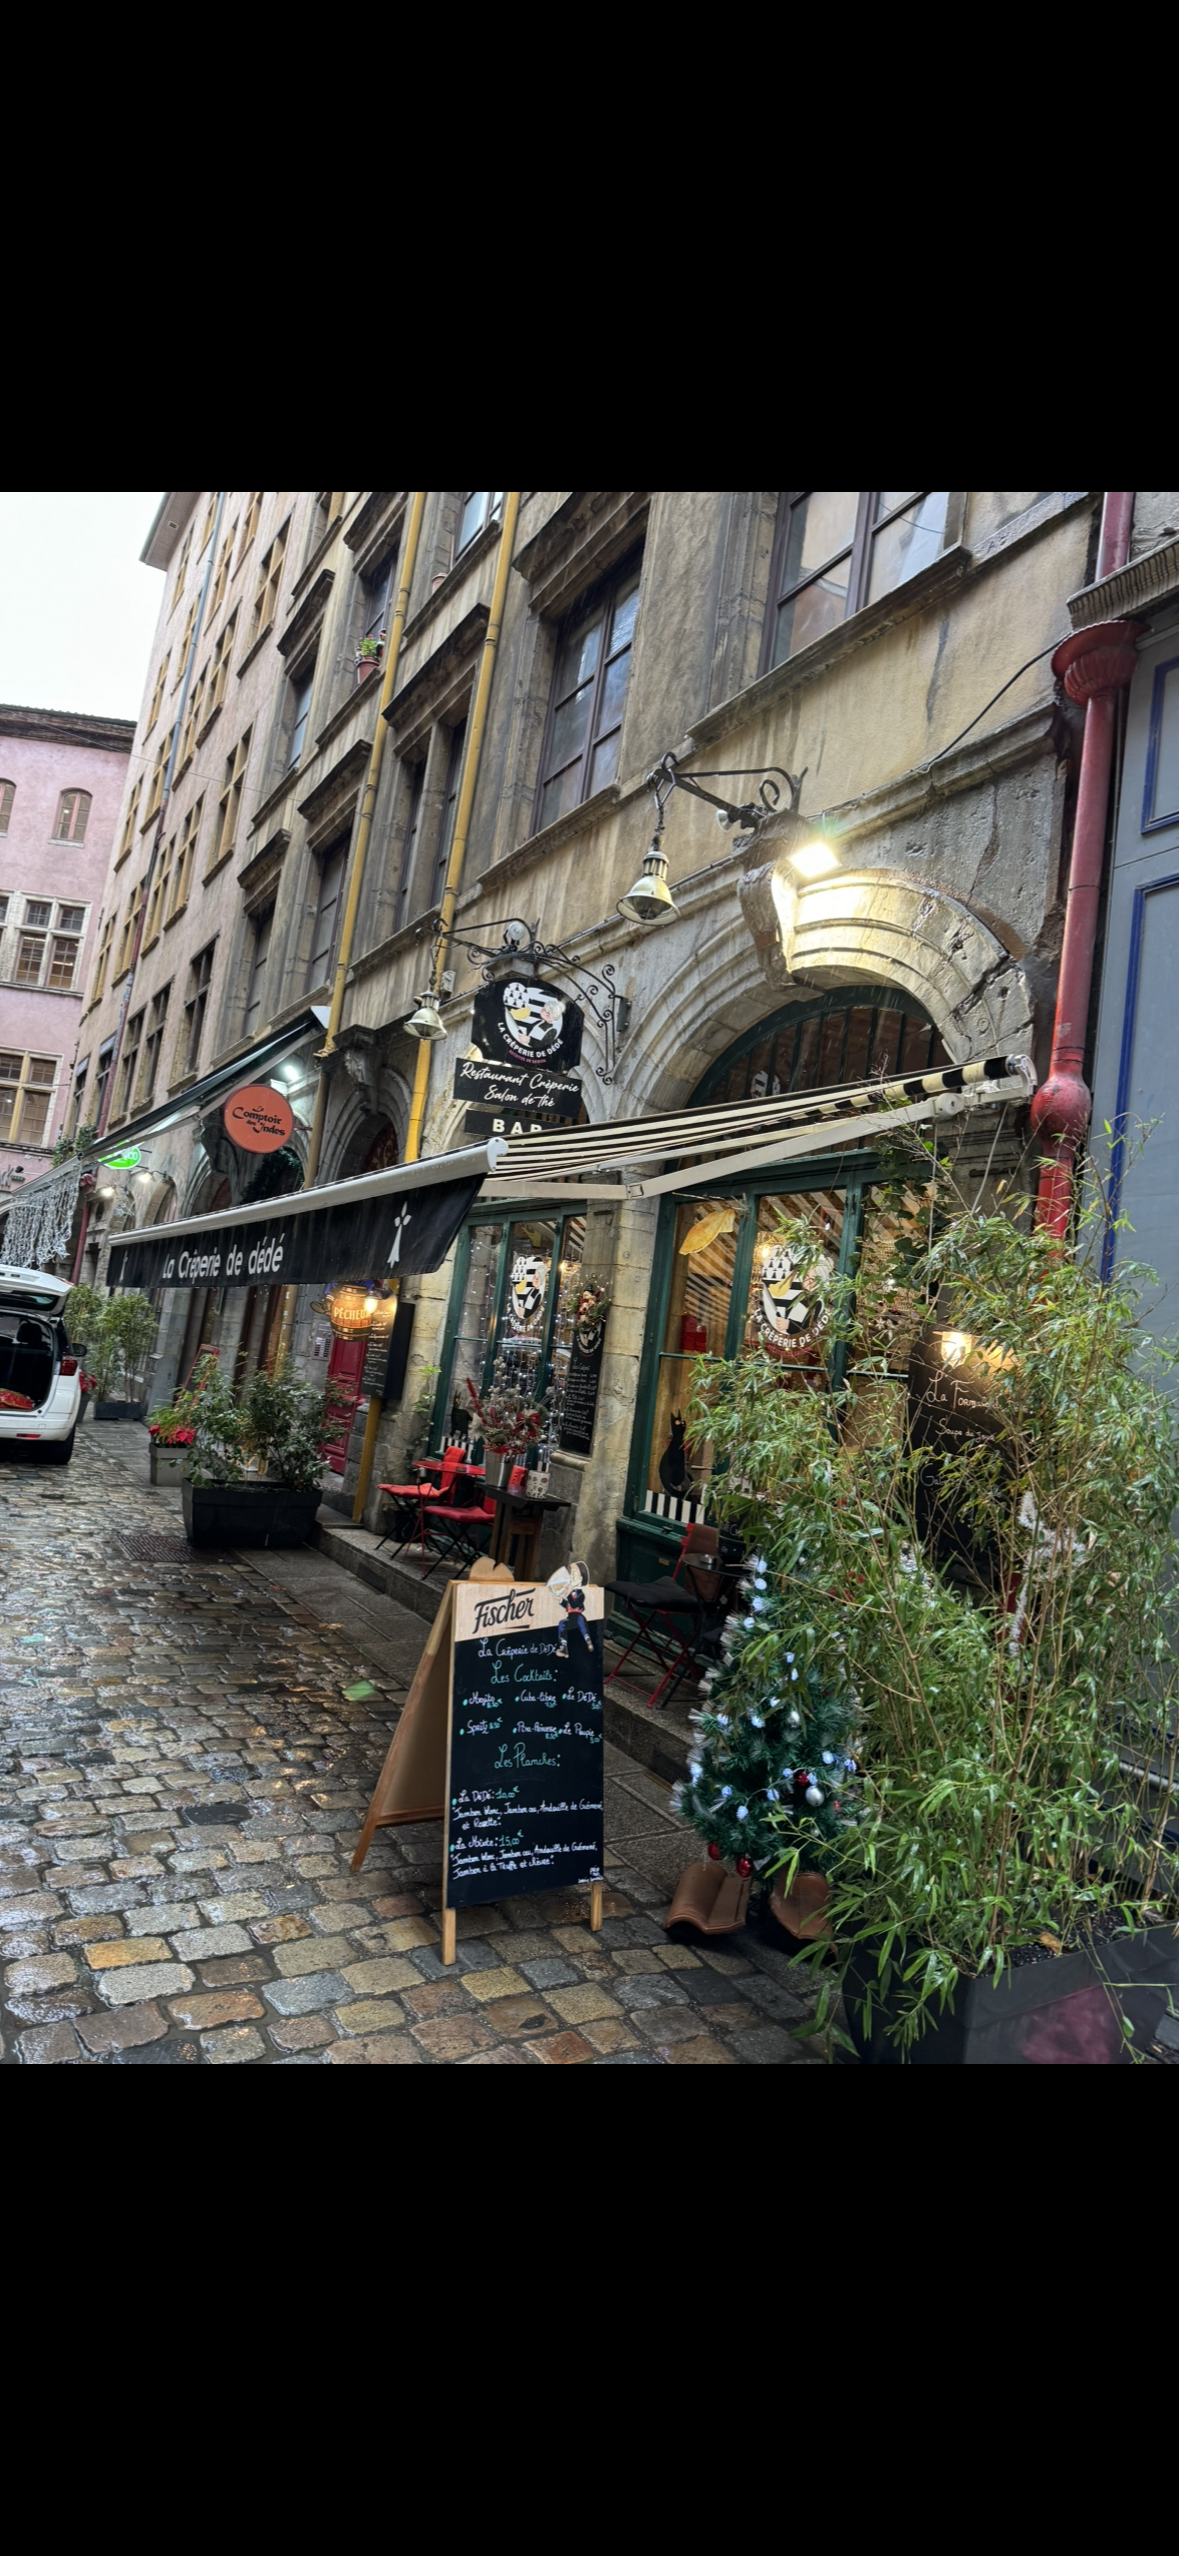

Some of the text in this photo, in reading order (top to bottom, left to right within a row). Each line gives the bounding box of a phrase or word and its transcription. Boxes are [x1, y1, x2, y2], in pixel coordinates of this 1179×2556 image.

[497, 1022, 505, 1033] LA
[502, 1033, 534, 1058] CRÊPERIE
[535, 1050, 546, 1058] DE
[460, 1061, 529, 1087] Restaurant
[484, 1084, 518, 1102] Salon
[521, 1094, 535, 1106] de
[232, 1106, 282, 1125] Comptoir
[162, 1233, 286, 1284] La Crêperie de dédé
[760, 1322, 797, 1348] CRÊPERIE
[935, 1418, 963, 1439] Soupe
[472, 1588, 536, 1634] Fischer
[478, 1637, 493, 1658] La
[530, 1645, 538, 1653] de
[490, 1660, 510, 1684] Les
[469, 1691, 495, 1706] Mojito
[566, 1686, 575, 1700] Le
[563, 1722, 572, 1735] Le
[494, 1744, 513, 1769] Les
[458, 1789, 470, 1803] La
[455, 1837, 467, 1850] La
